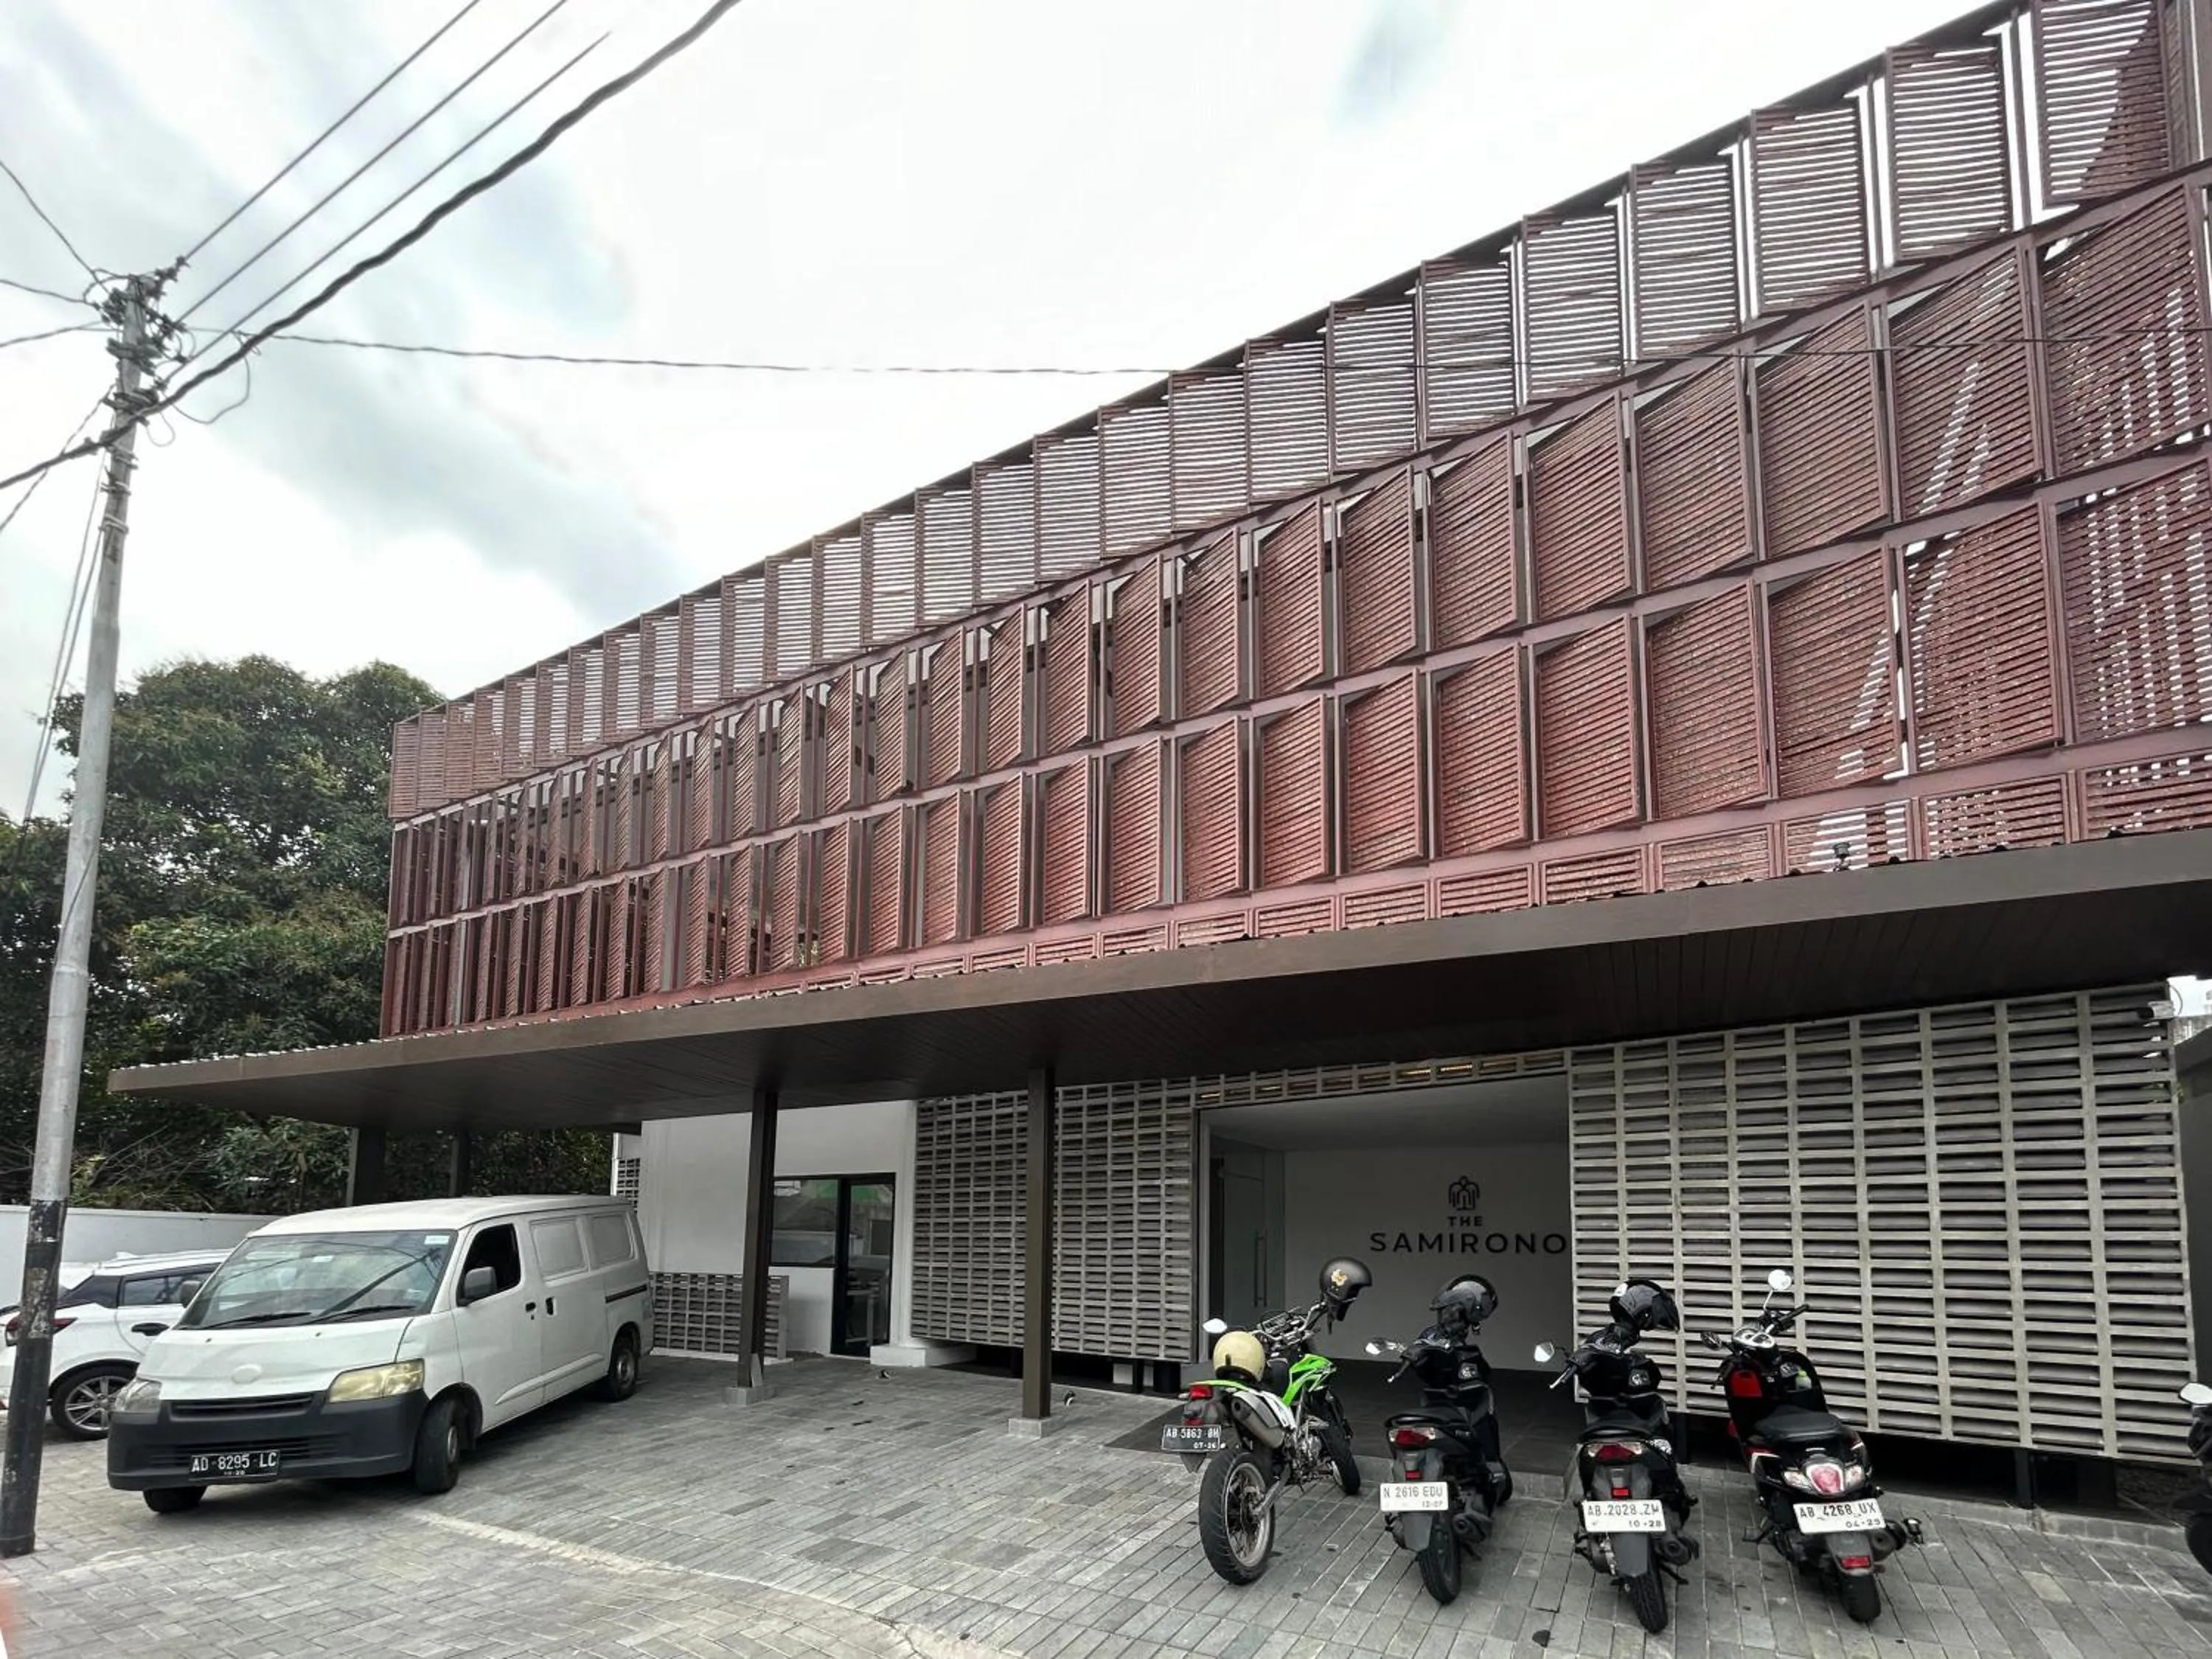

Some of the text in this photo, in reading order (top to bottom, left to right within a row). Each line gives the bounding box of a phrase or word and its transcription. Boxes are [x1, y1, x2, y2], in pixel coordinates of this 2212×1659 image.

[1447, 1216, 1484, 1227] THE
[1369, 1232, 1567, 1254] SAMIRONO
[192, 1452, 276, 1472] AD 8295 LC
[1383, 1486, 1391, 1498] N
[1587, 1505, 1601, 1517] AB
[1607, 1504, 1637, 1516] 2028
[1799, 1502, 1877, 1518] AB 4268 UX
